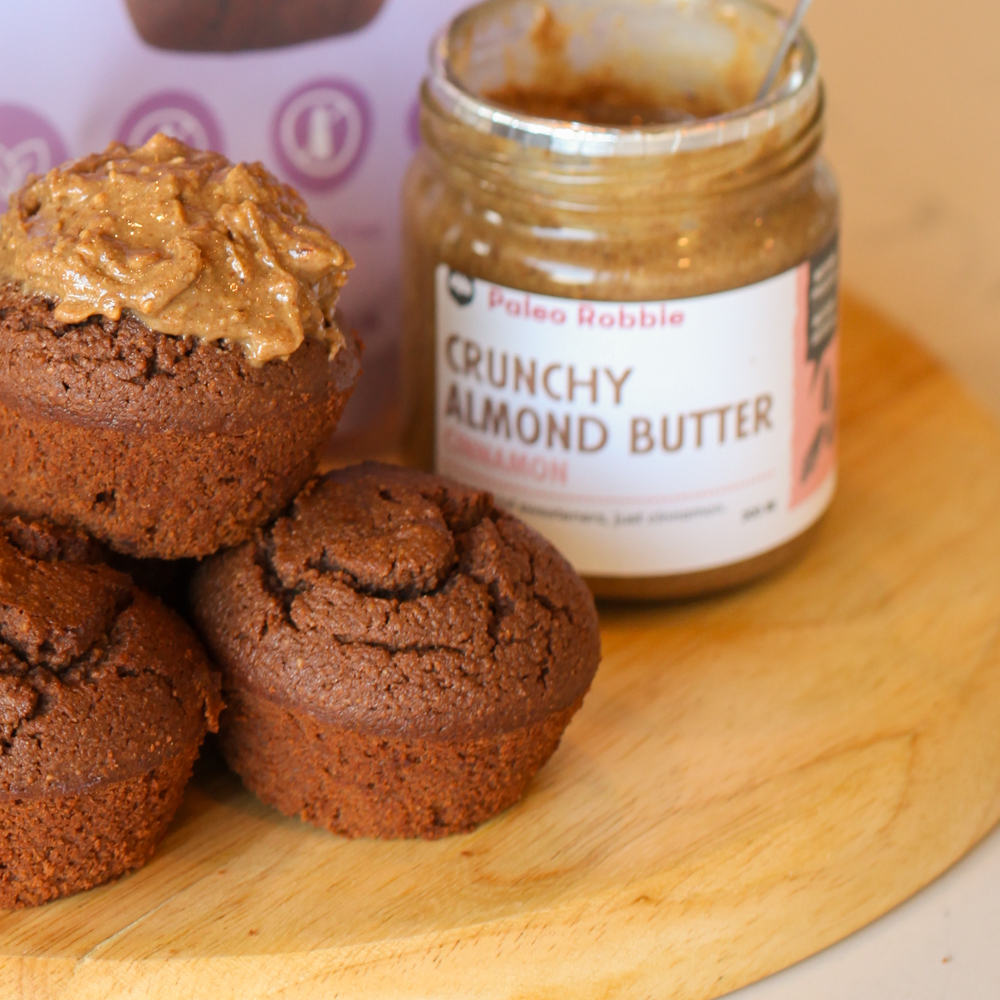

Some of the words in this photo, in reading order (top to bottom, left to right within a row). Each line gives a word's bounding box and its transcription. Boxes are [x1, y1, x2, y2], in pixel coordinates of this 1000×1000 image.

[488, 286, 567, 326] Paleo
[577, 302, 686, 331] Robbie
[445, 333, 634, 406] CRUNCHY
[445, 384, 609, 454] ALMOND
[630, 393, 775, 455] BUTTER
